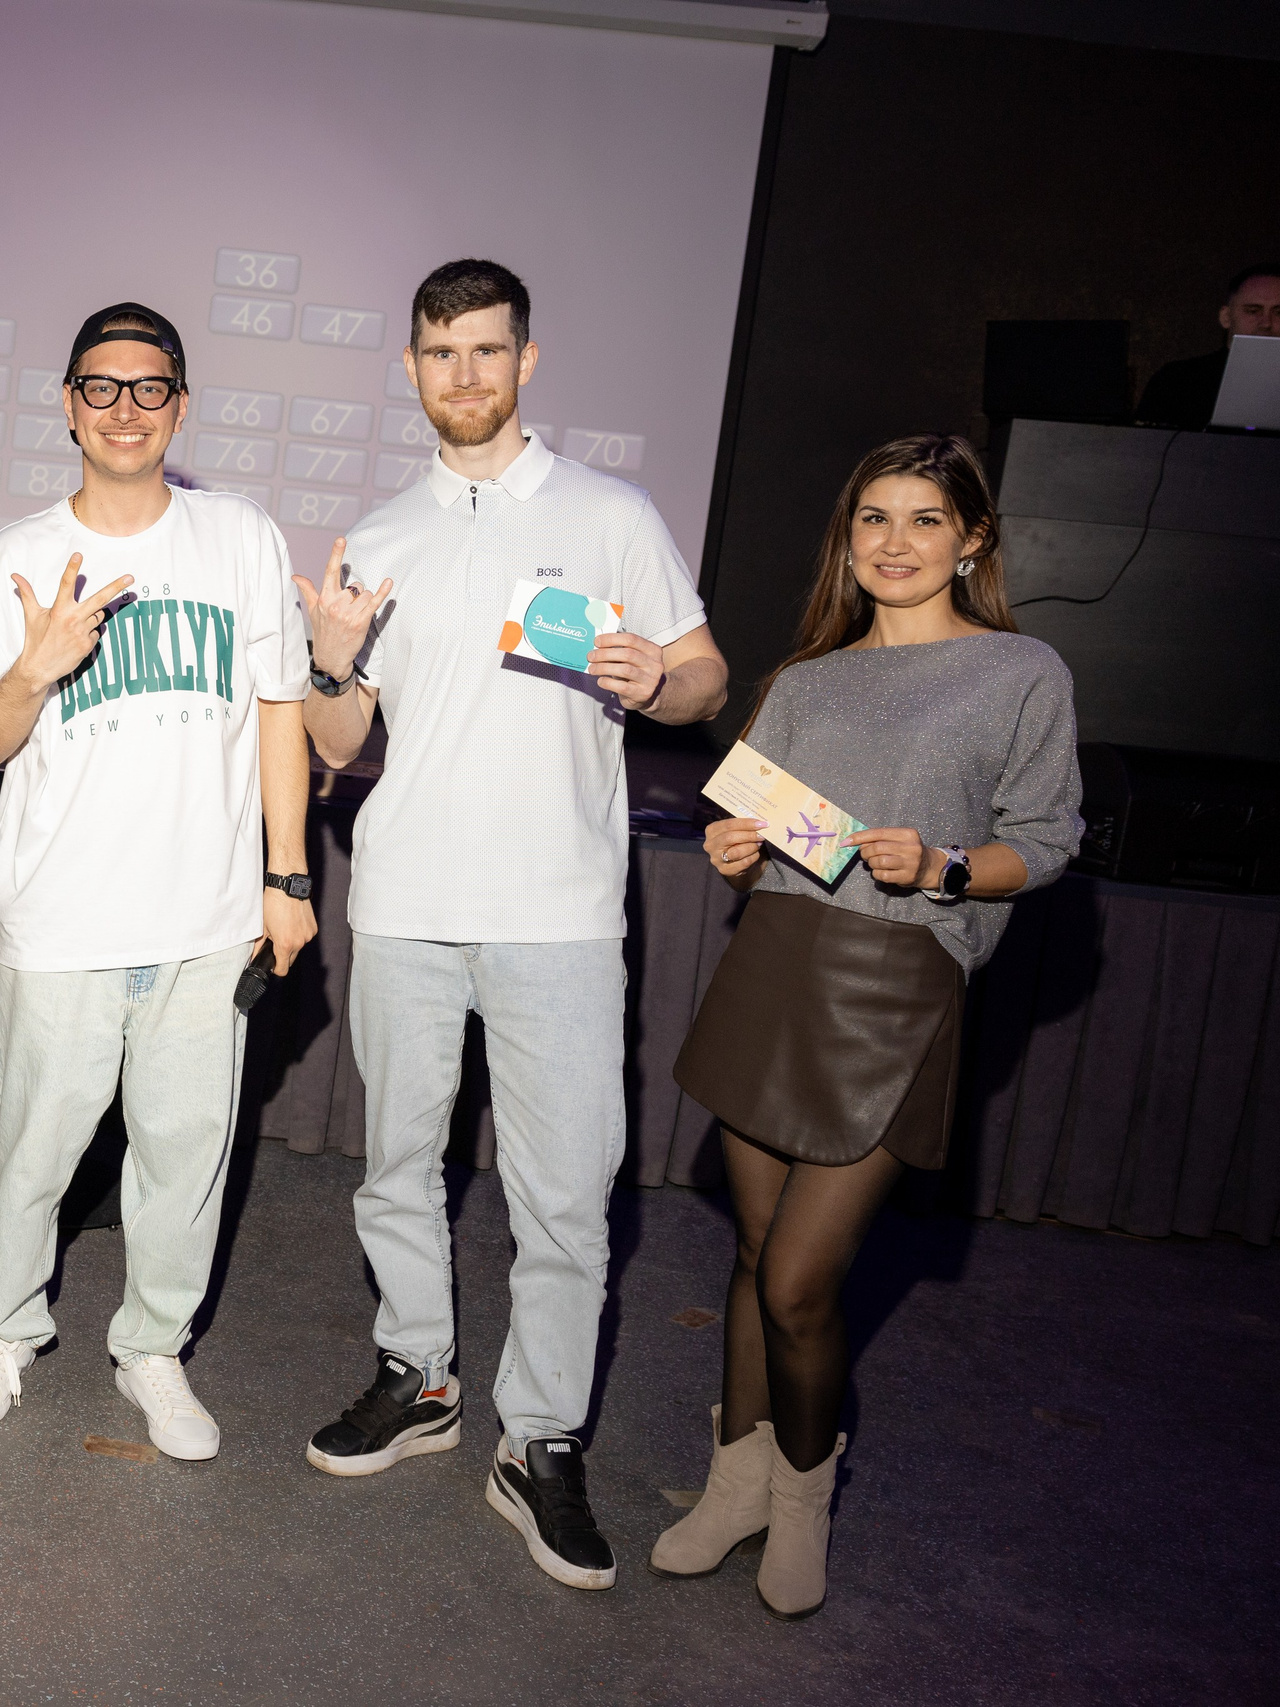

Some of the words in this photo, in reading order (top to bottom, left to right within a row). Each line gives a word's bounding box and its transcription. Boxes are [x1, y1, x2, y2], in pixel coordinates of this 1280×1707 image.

[235, 253, 278, 290] 36
[231, 302, 272, 336] 46
[321, 311, 366, 344] 47
[38, 373, 59, 405] 6
[220, 393, 261, 427] 66
[311, 402, 355, 435] 67
[401, 412, 439, 447] 68
[583, 432, 626, 468] 70
[34, 418, 71, 453] 74
[216, 437, 256, 472] 76
[305, 446, 350, 481] 77
[28, 464, 71, 499] 84
[298, 493, 345, 528] 87
[536, 567, 564, 578] BOSS
[122, 583, 171, 601] 898
[532, 614, 585, 638] Эпиляшка
[64, 719, 119, 741] NEW
[156, 706, 231, 727] YORK
[386, 1359, 407, 1376] PUMA
[546, 1442, 571, 1454] PUMA
